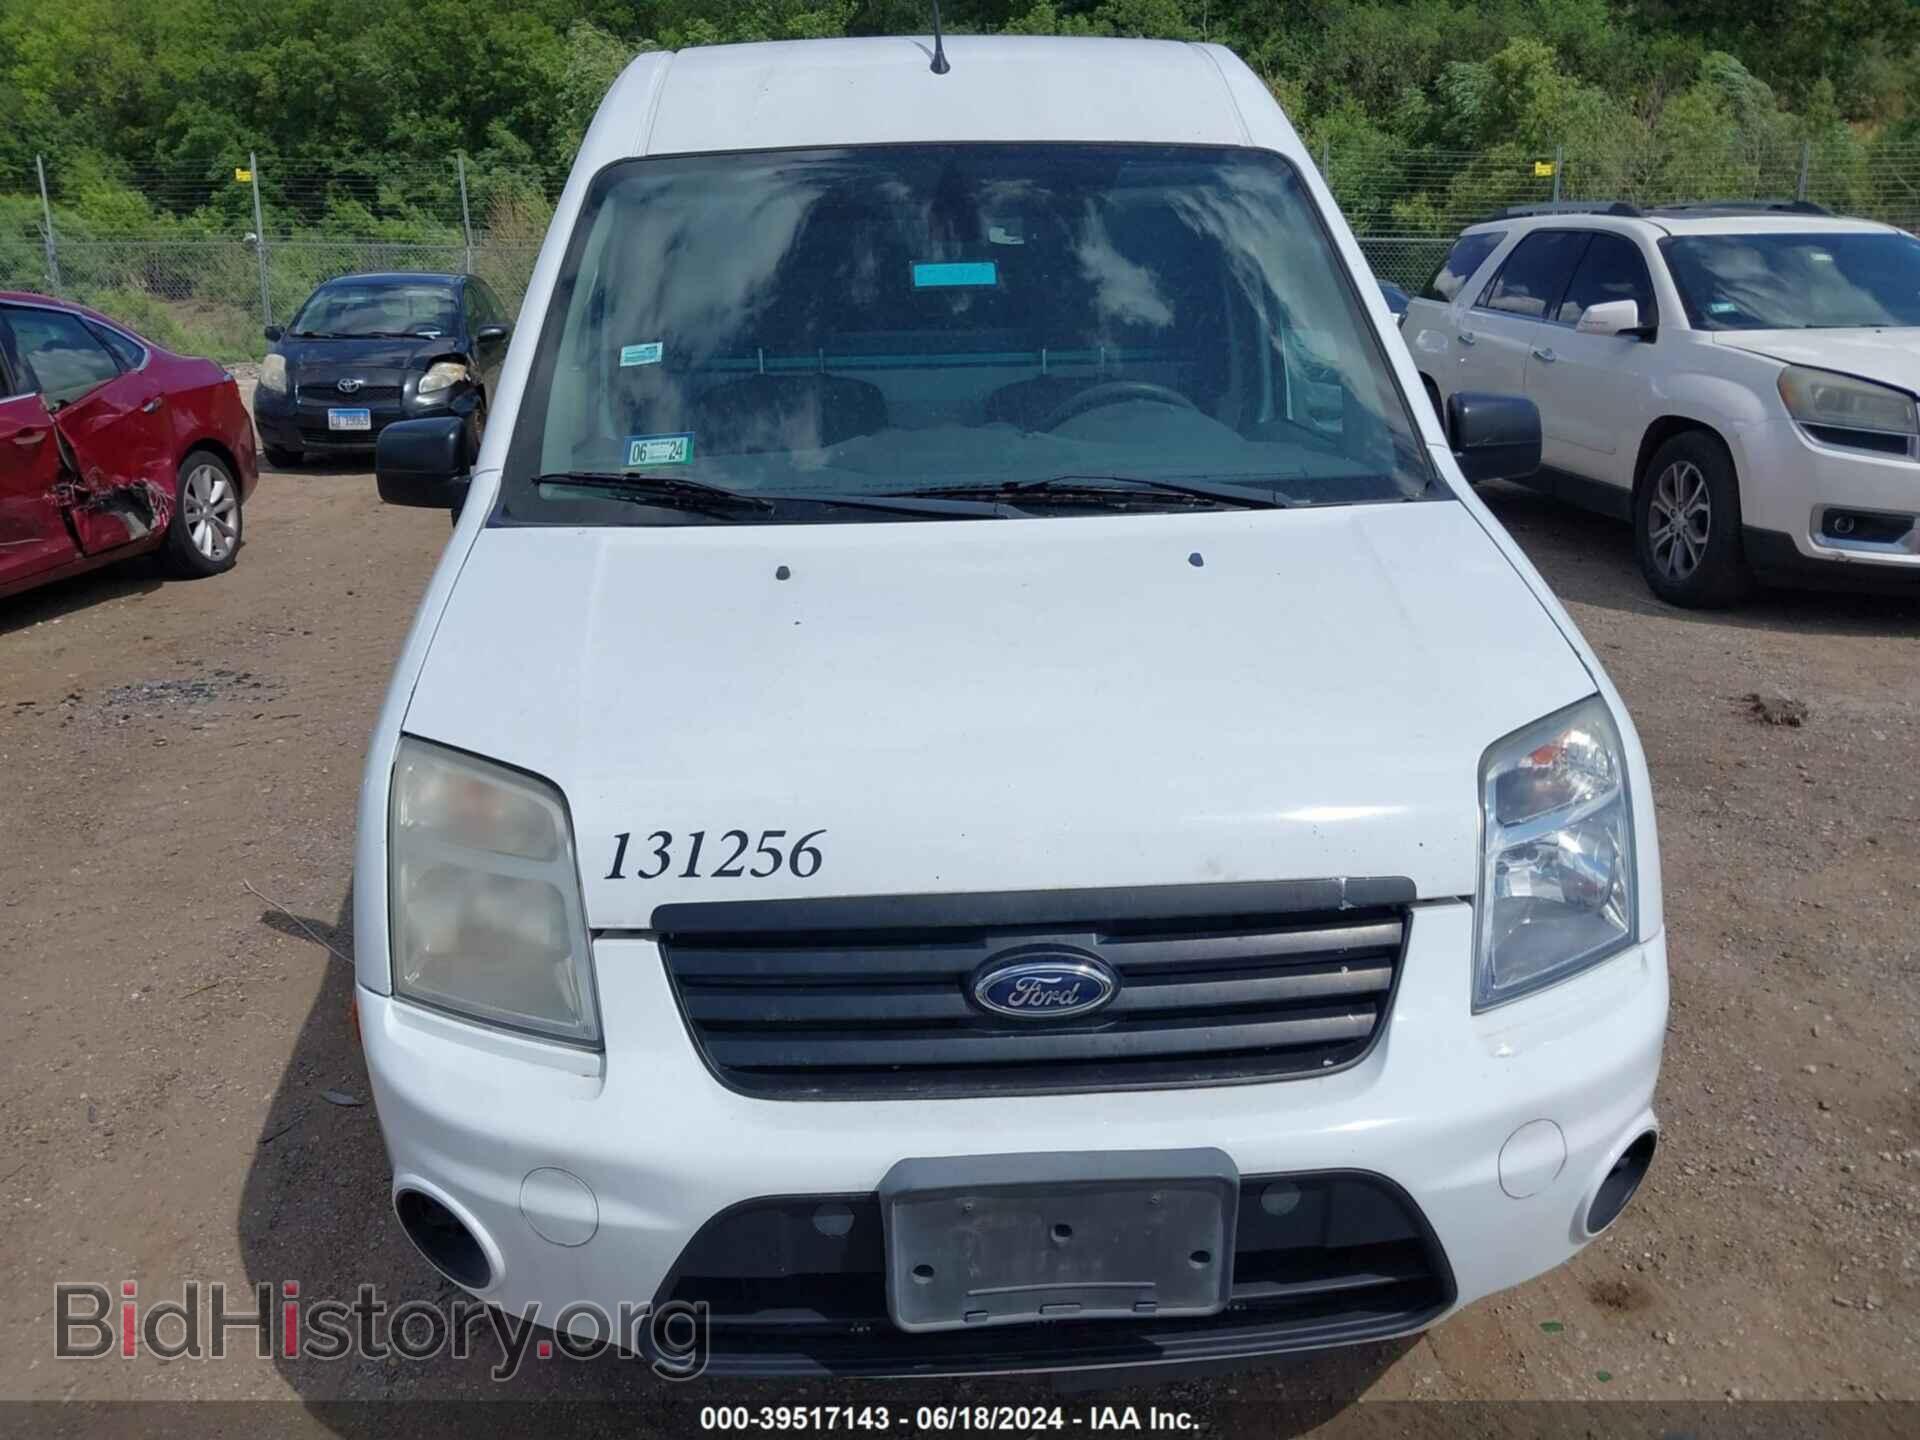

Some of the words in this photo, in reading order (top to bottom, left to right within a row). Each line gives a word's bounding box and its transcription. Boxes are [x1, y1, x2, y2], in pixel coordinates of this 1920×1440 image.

[632, 442, 648, 462] 06
[668, 440, 684, 460] 24
[603, 829, 827, 880] 131256
[1008, 976, 1081, 1007] Ford
